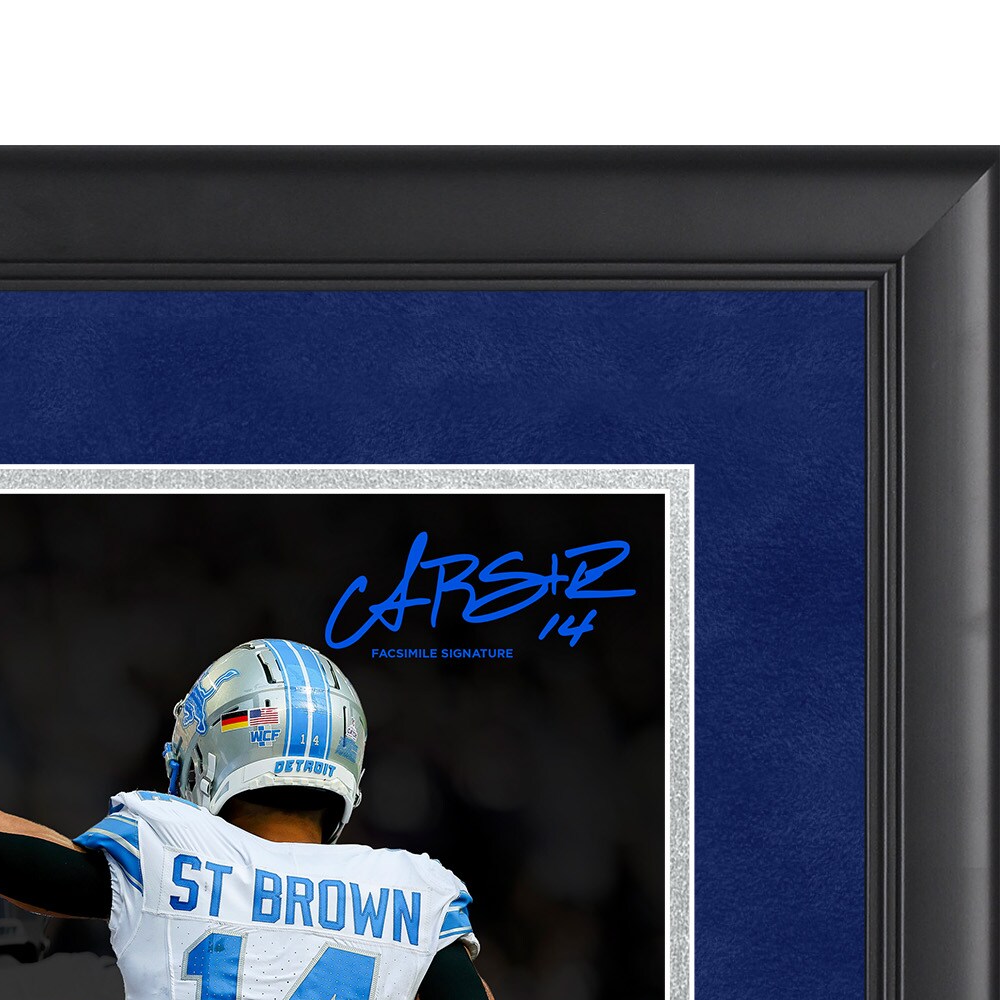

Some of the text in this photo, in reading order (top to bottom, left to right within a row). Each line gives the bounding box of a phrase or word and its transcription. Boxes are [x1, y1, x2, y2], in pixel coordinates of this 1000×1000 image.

[538, 609, 598, 648] 14
[250, 728, 281, 742] WCF
[274, 759, 337, 777] DETROIT
[169, 853, 421, 946] ST BROWN
